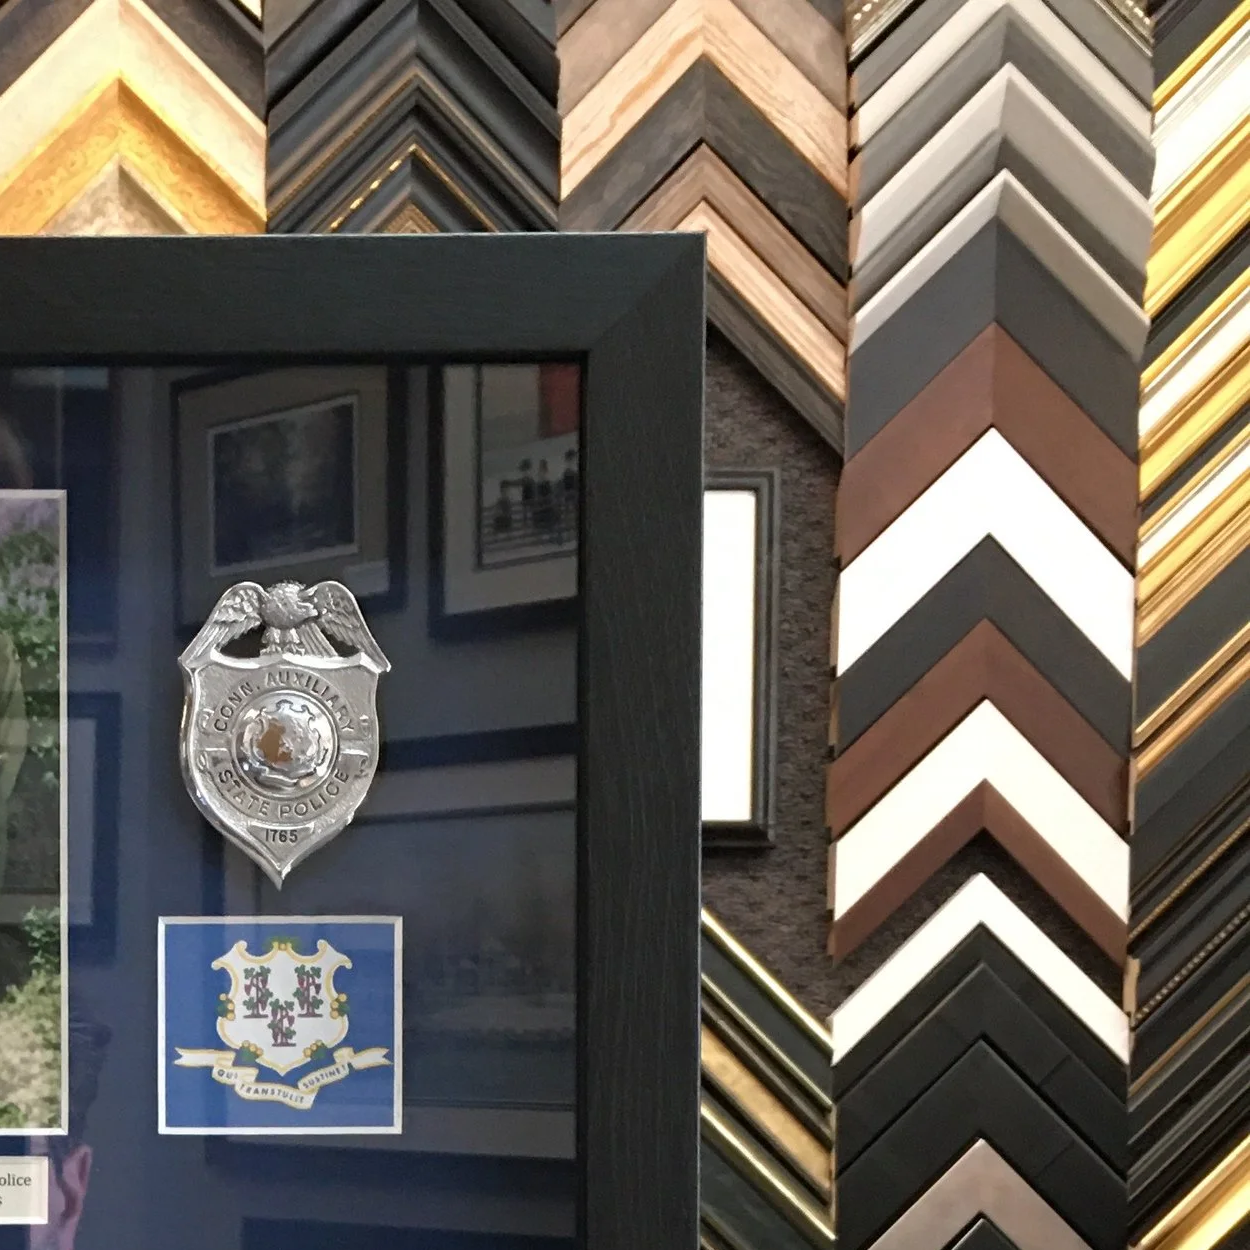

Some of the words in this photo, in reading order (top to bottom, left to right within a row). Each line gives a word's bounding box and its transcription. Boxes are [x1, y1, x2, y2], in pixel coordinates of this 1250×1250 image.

[266, 671, 355, 733] AUXILIARY
[218, 769, 270, 816] STATE
[278, 768, 350, 818] POLICE
[265, 829, 298, 843] 1765
